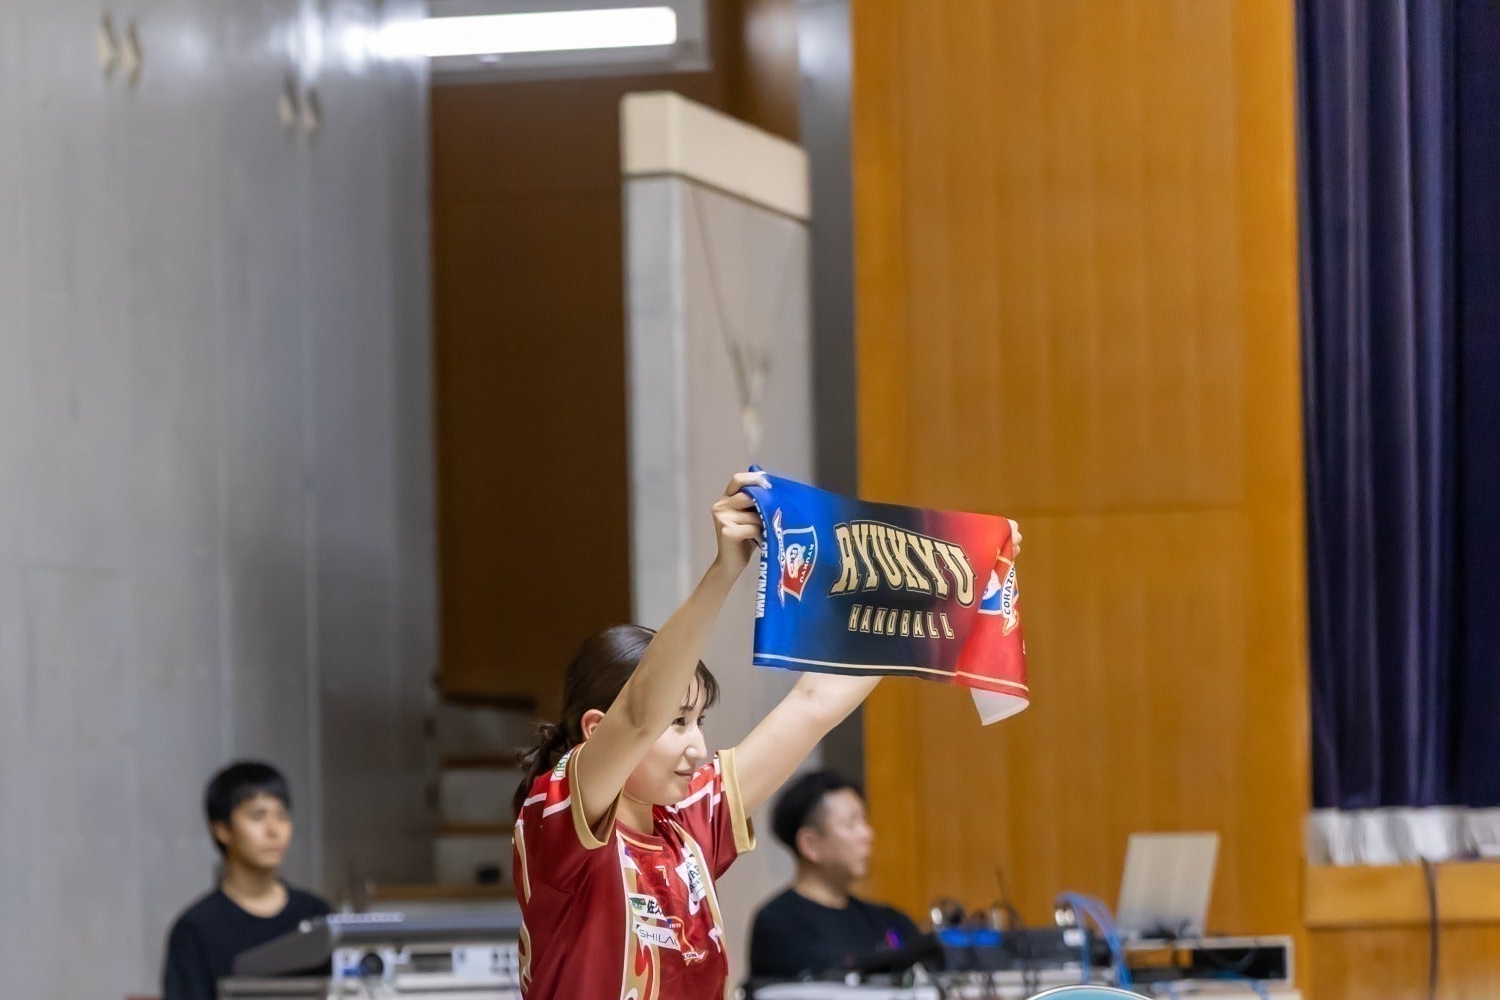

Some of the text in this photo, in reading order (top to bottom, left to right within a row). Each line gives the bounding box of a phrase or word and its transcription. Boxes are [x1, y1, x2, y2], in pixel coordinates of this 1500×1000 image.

[827, 520, 977, 608] RYUKYU
[848, 603, 954, 639] HANDBALL
[639, 929, 678, 947] SHILA
